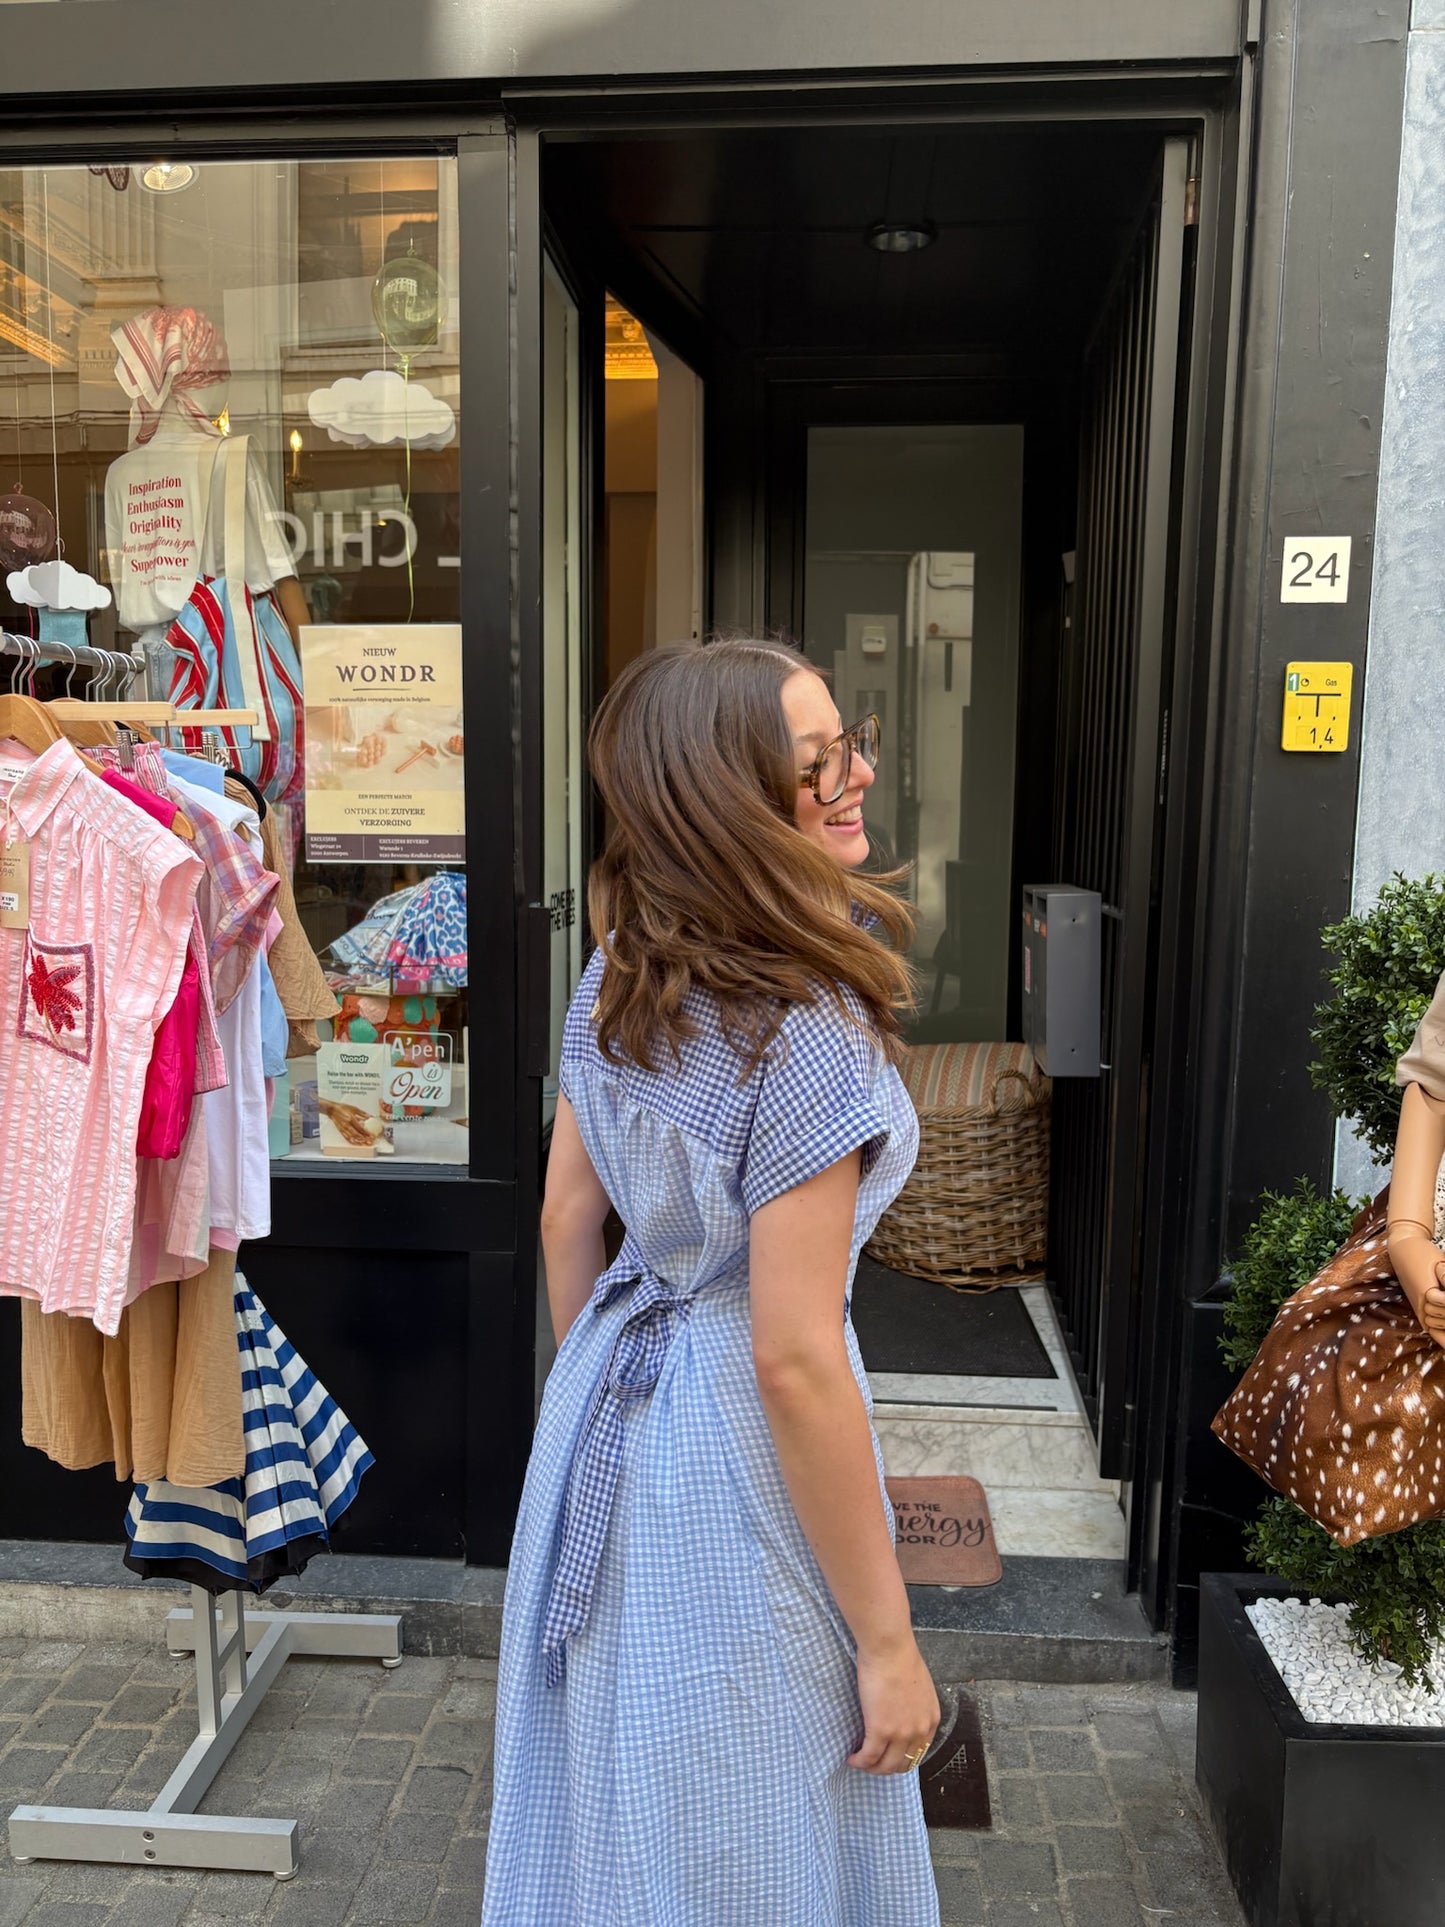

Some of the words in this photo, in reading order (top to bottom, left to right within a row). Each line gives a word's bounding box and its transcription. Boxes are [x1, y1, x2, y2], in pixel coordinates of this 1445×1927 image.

[129, 476, 182, 496] Inspiration
[127, 497, 184, 516] Enthusiasm
[130, 515, 182, 536] Originality
[1289, 551, 1341, 588] 24
[363, 648, 397, 657] NIEUW
[336, 664, 436, 683] WONDR
[1325, 678, 1338, 687] Gas
[391, 808, 425, 816] ZUIVERE
[360, 819, 412, 827] VERZORGING
[340, 1053, 369, 1064] Wondr
[426, 1066, 438, 1079] is
[391, 1071, 443, 1104] Open
[913, 1502, 941, 1511] THE
